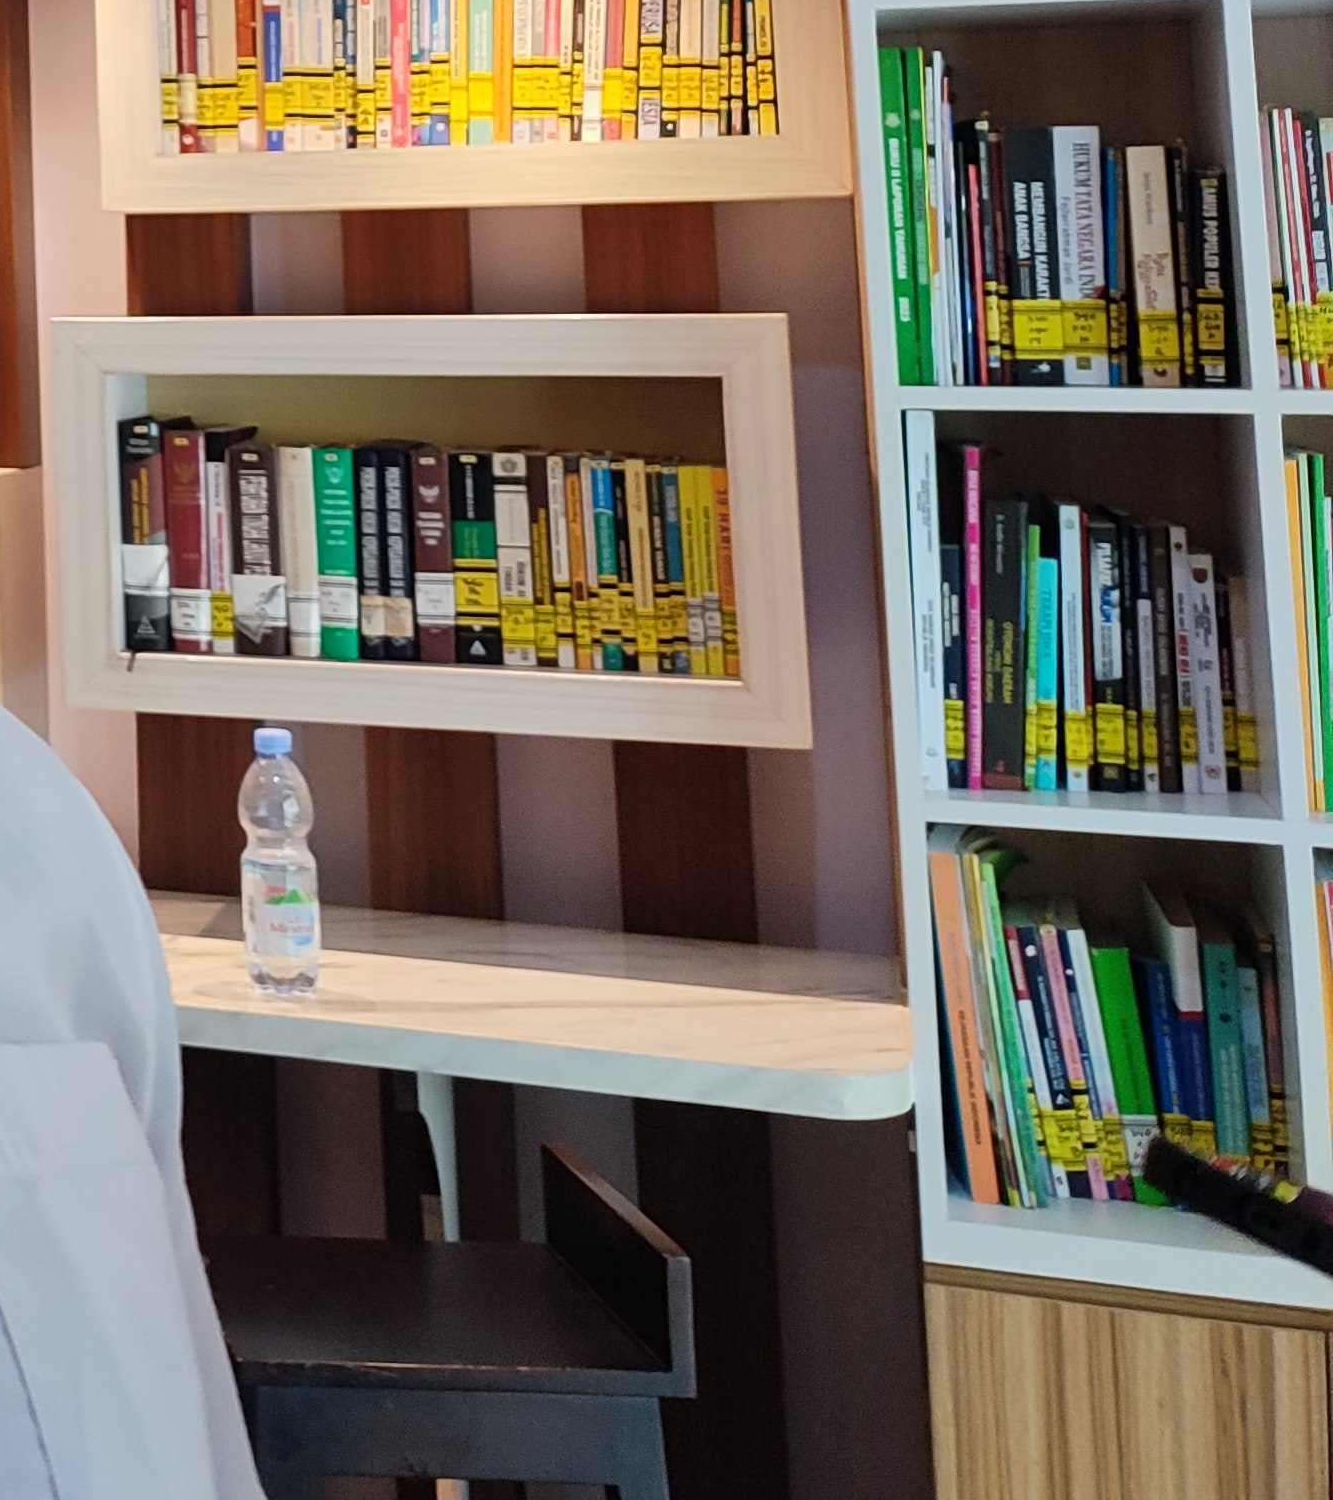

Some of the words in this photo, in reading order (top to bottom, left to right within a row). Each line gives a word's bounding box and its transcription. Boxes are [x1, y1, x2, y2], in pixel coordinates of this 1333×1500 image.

[1073, 142, 1093, 188] HUKUM
[1013, 181, 1029, 213] ANAK
[1030, 181, 1048, 253] MEMBANGUN
[1074, 190, 1093, 221] TATA
[1015, 213, 1032, 260] BANGSA
[1077, 223, 1096, 271] NEGARA
[1079, 273, 1097, 299] IND
